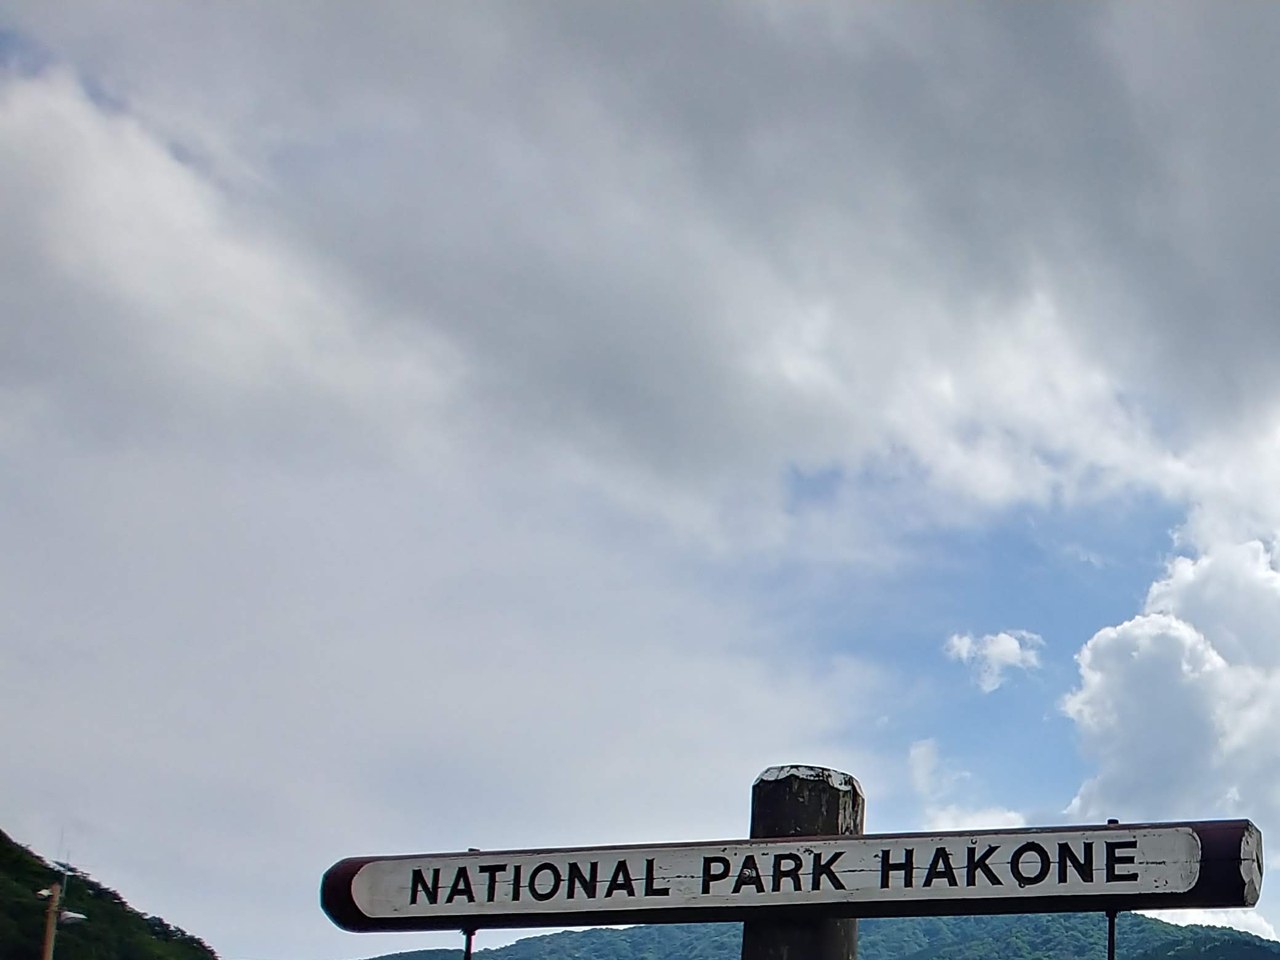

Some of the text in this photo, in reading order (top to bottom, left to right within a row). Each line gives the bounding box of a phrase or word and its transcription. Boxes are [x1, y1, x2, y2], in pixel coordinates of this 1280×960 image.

[409, 840, 1139, 905] NATIONAL PARK HAKONE
